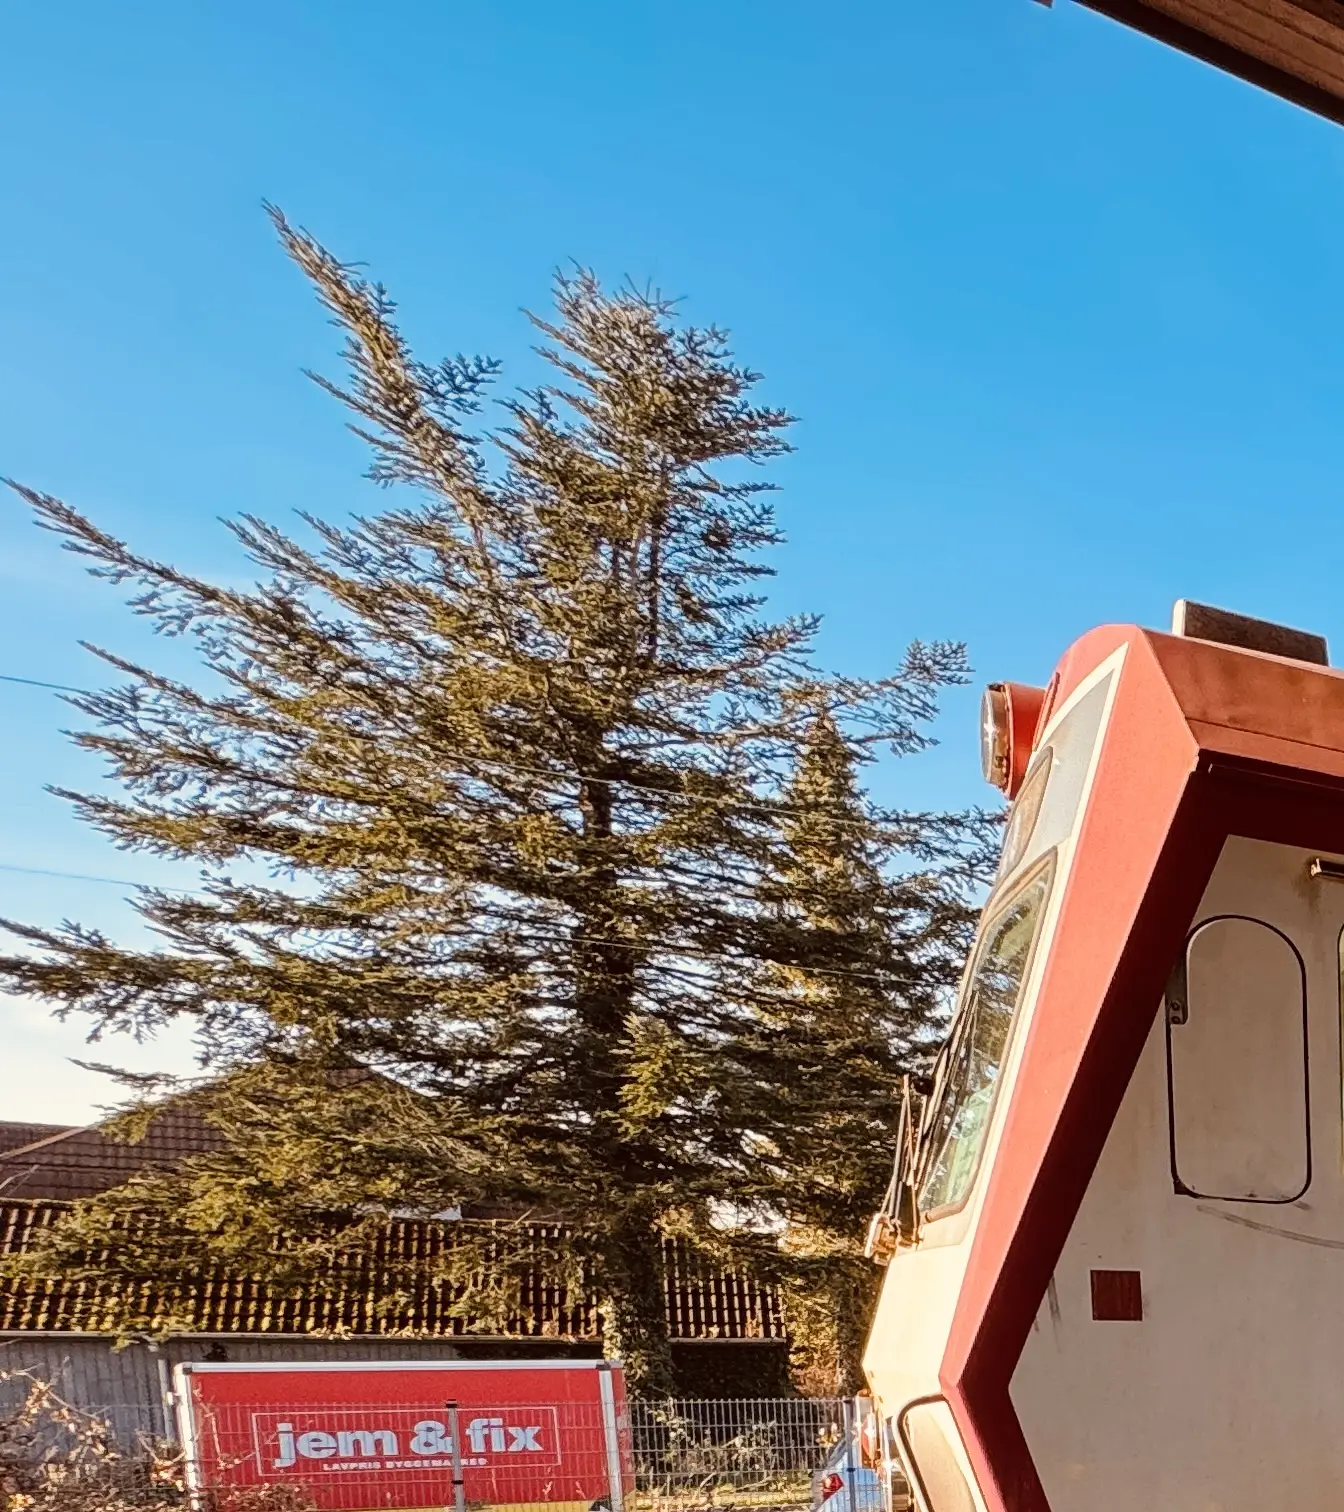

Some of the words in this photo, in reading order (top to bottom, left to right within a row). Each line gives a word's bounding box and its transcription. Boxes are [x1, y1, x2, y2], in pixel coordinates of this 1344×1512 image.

[275, 1422, 398, 1468] jem
[410, 1420, 453, 1454] &
[465, 1417, 544, 1453] fix
[322, 1462, 382, 1471] LAVPRIS
[385, 1457, 488, 1469] BYGGEMAKED
